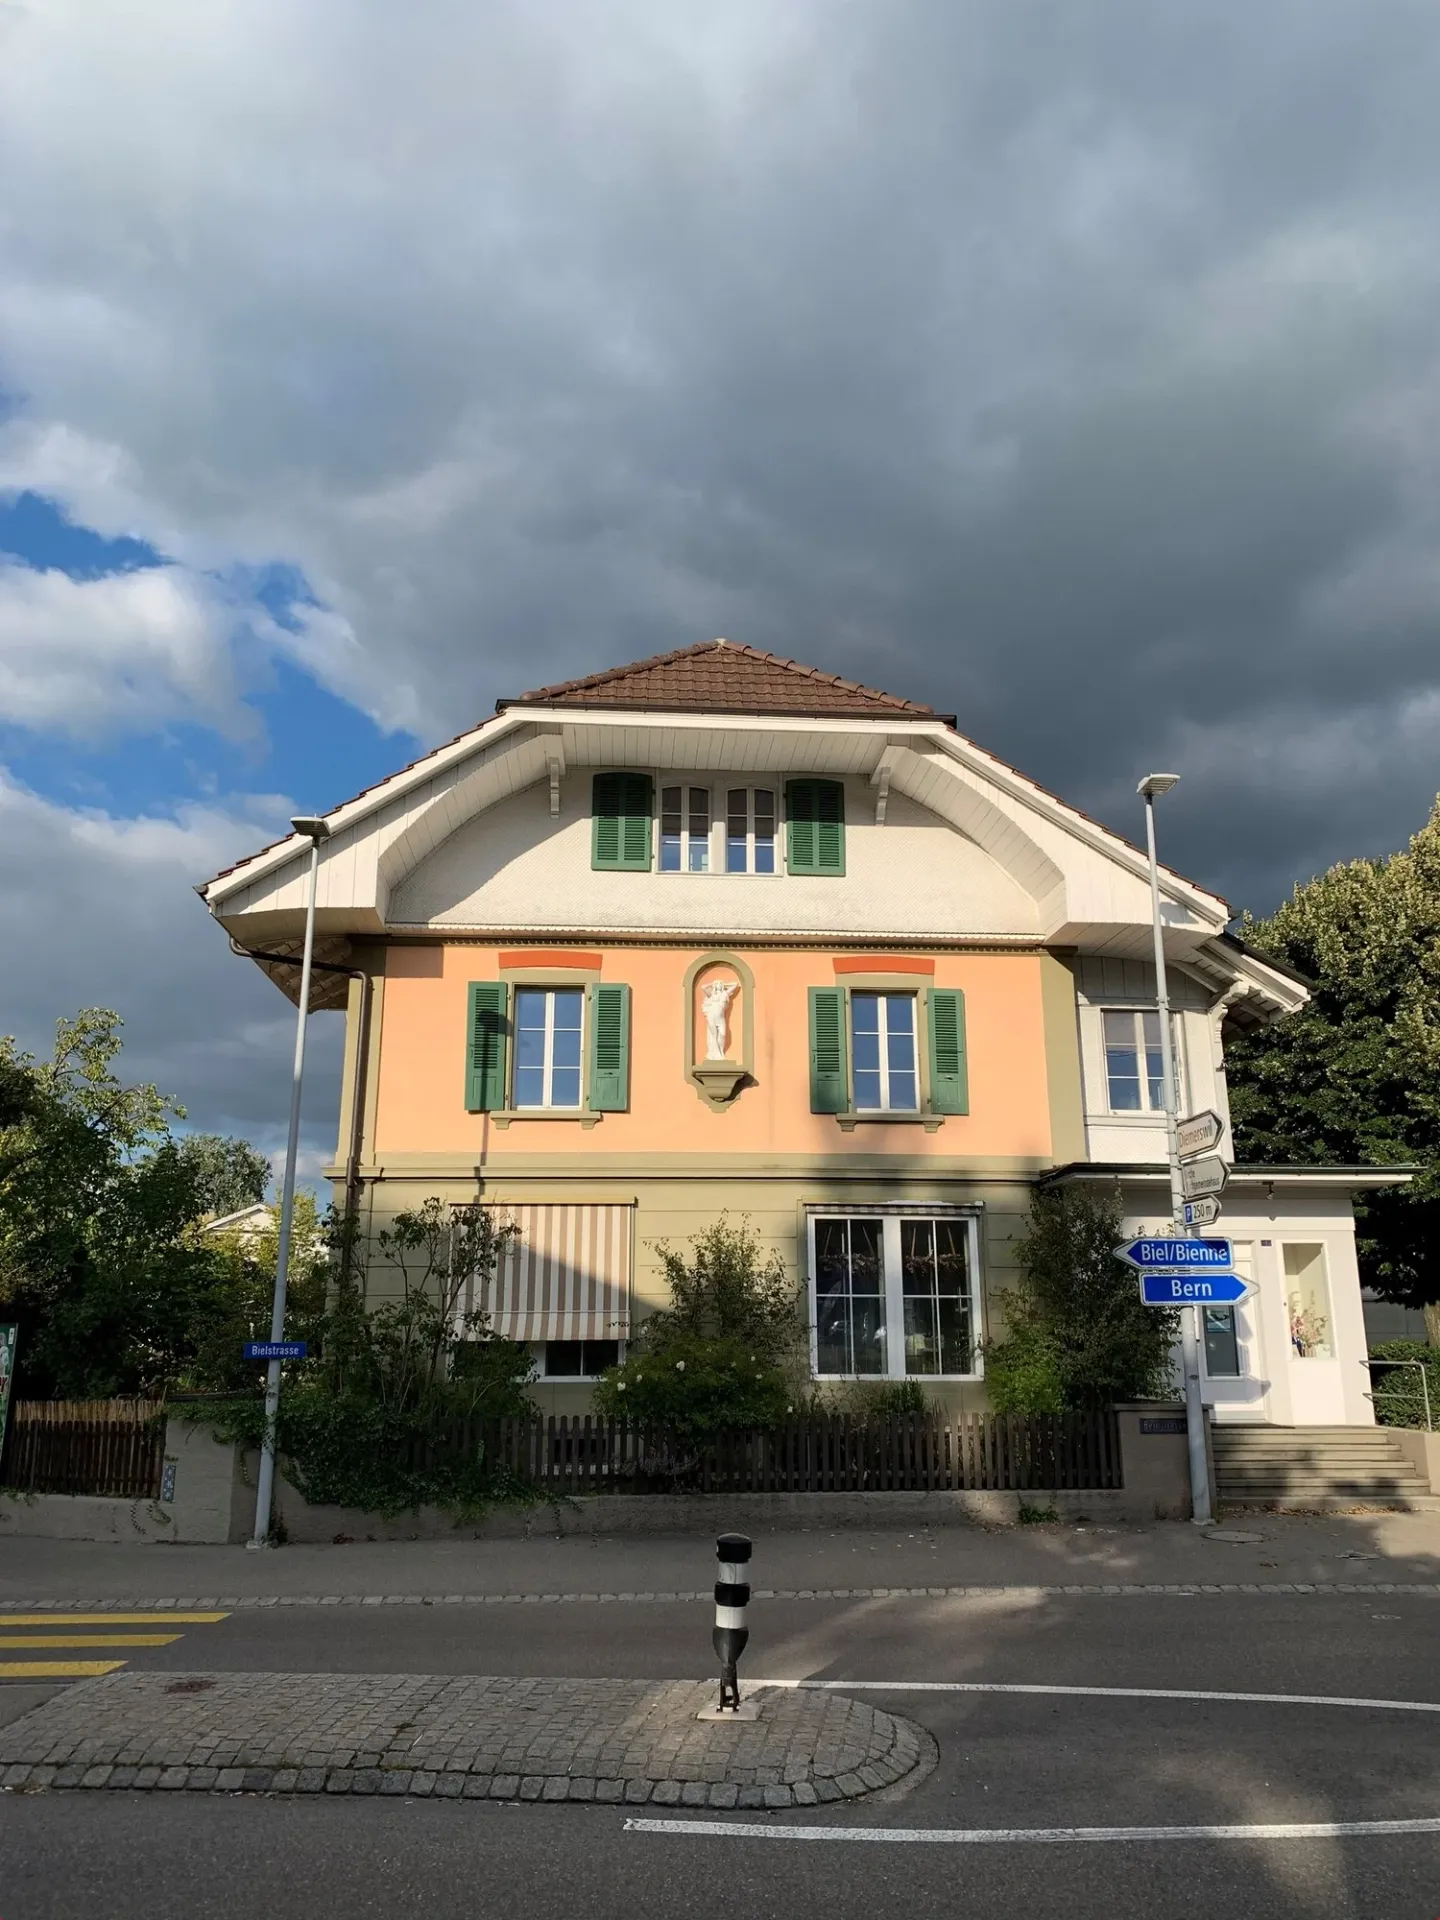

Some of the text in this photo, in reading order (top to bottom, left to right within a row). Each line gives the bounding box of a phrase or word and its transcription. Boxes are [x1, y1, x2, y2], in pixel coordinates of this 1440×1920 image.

[1180, 1119, 1212, 1147] Diemerswil
[1193, 1203, 1205, 1218] 250
[1206, 1205, 1212, 1216] m
[1141, 1243, 1228, 1261] Biel/Bienne
[1171, 1279, 1212, 1297] Bern
[251, 1345, 300, 1356] Bielstrasse
